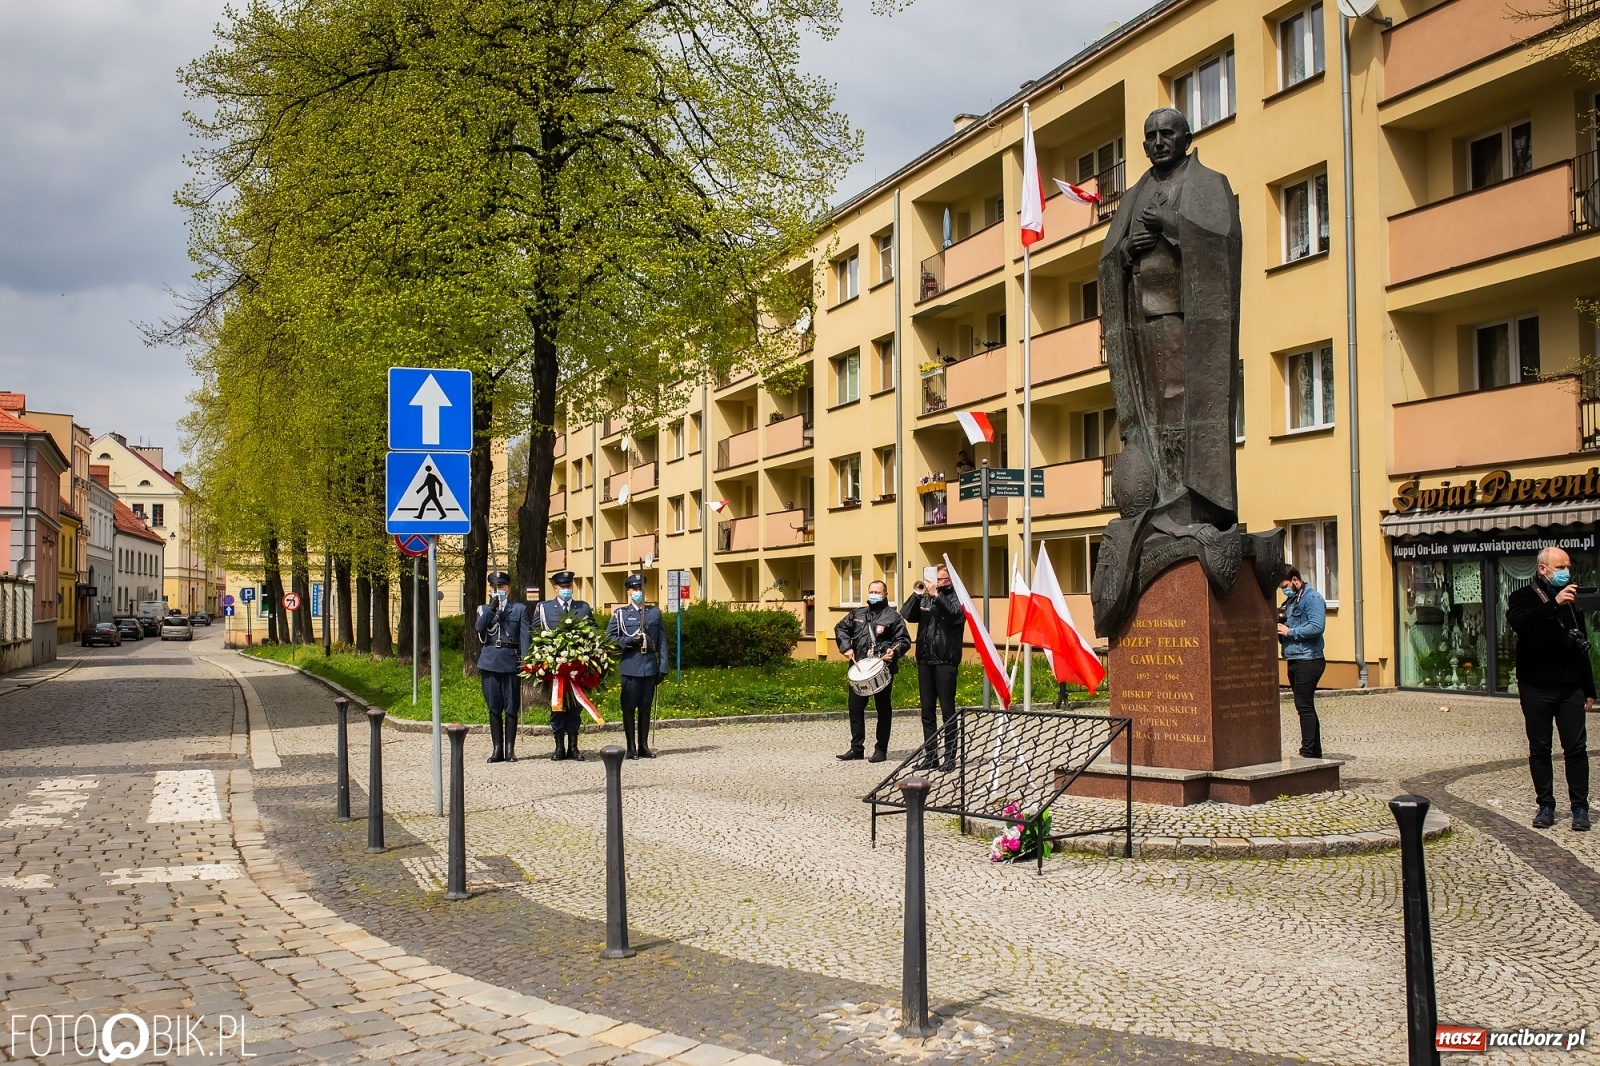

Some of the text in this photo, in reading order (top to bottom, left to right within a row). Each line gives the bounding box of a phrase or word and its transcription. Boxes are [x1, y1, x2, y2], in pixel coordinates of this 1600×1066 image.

[1392, 467, 1600, 511] Świat Prezent
[1393, 534, 1595, 559] Kupuj On-Line www.swiatprezentow.com.pl
[1158, 637, 1200, 648] FELIKS
[1130, 655, 1184, 665] GAWLINA
[1164, 673, 1180, 681] 1964
[1122, 690, 1195, 701] BISKUP POLOWY
[1120, 703, 1198, 715] WOJSK POLSKICH
[1139, 719, 1178, 727] OPIEKUN
[1117, 730, 1207, 743] MGRACJI POLSKIEJ
